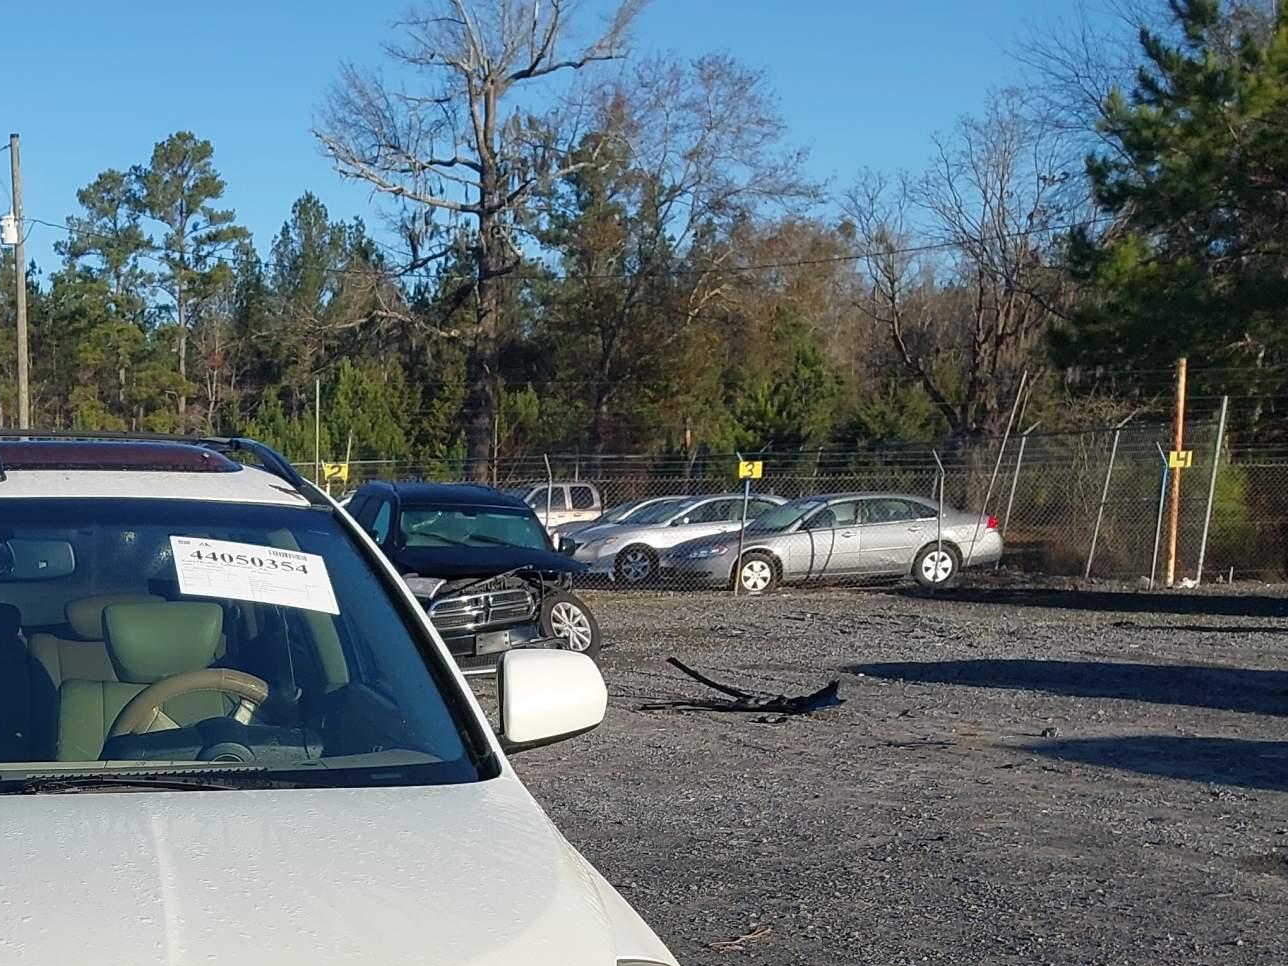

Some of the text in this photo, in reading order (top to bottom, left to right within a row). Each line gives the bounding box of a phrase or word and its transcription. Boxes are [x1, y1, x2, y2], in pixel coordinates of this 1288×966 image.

[1175, 450, 1190, 468] 4
[326, 464, 343, 480] 2
[744, 461, 756, 477] 3
[189, 549, 309, 575] 44050354
